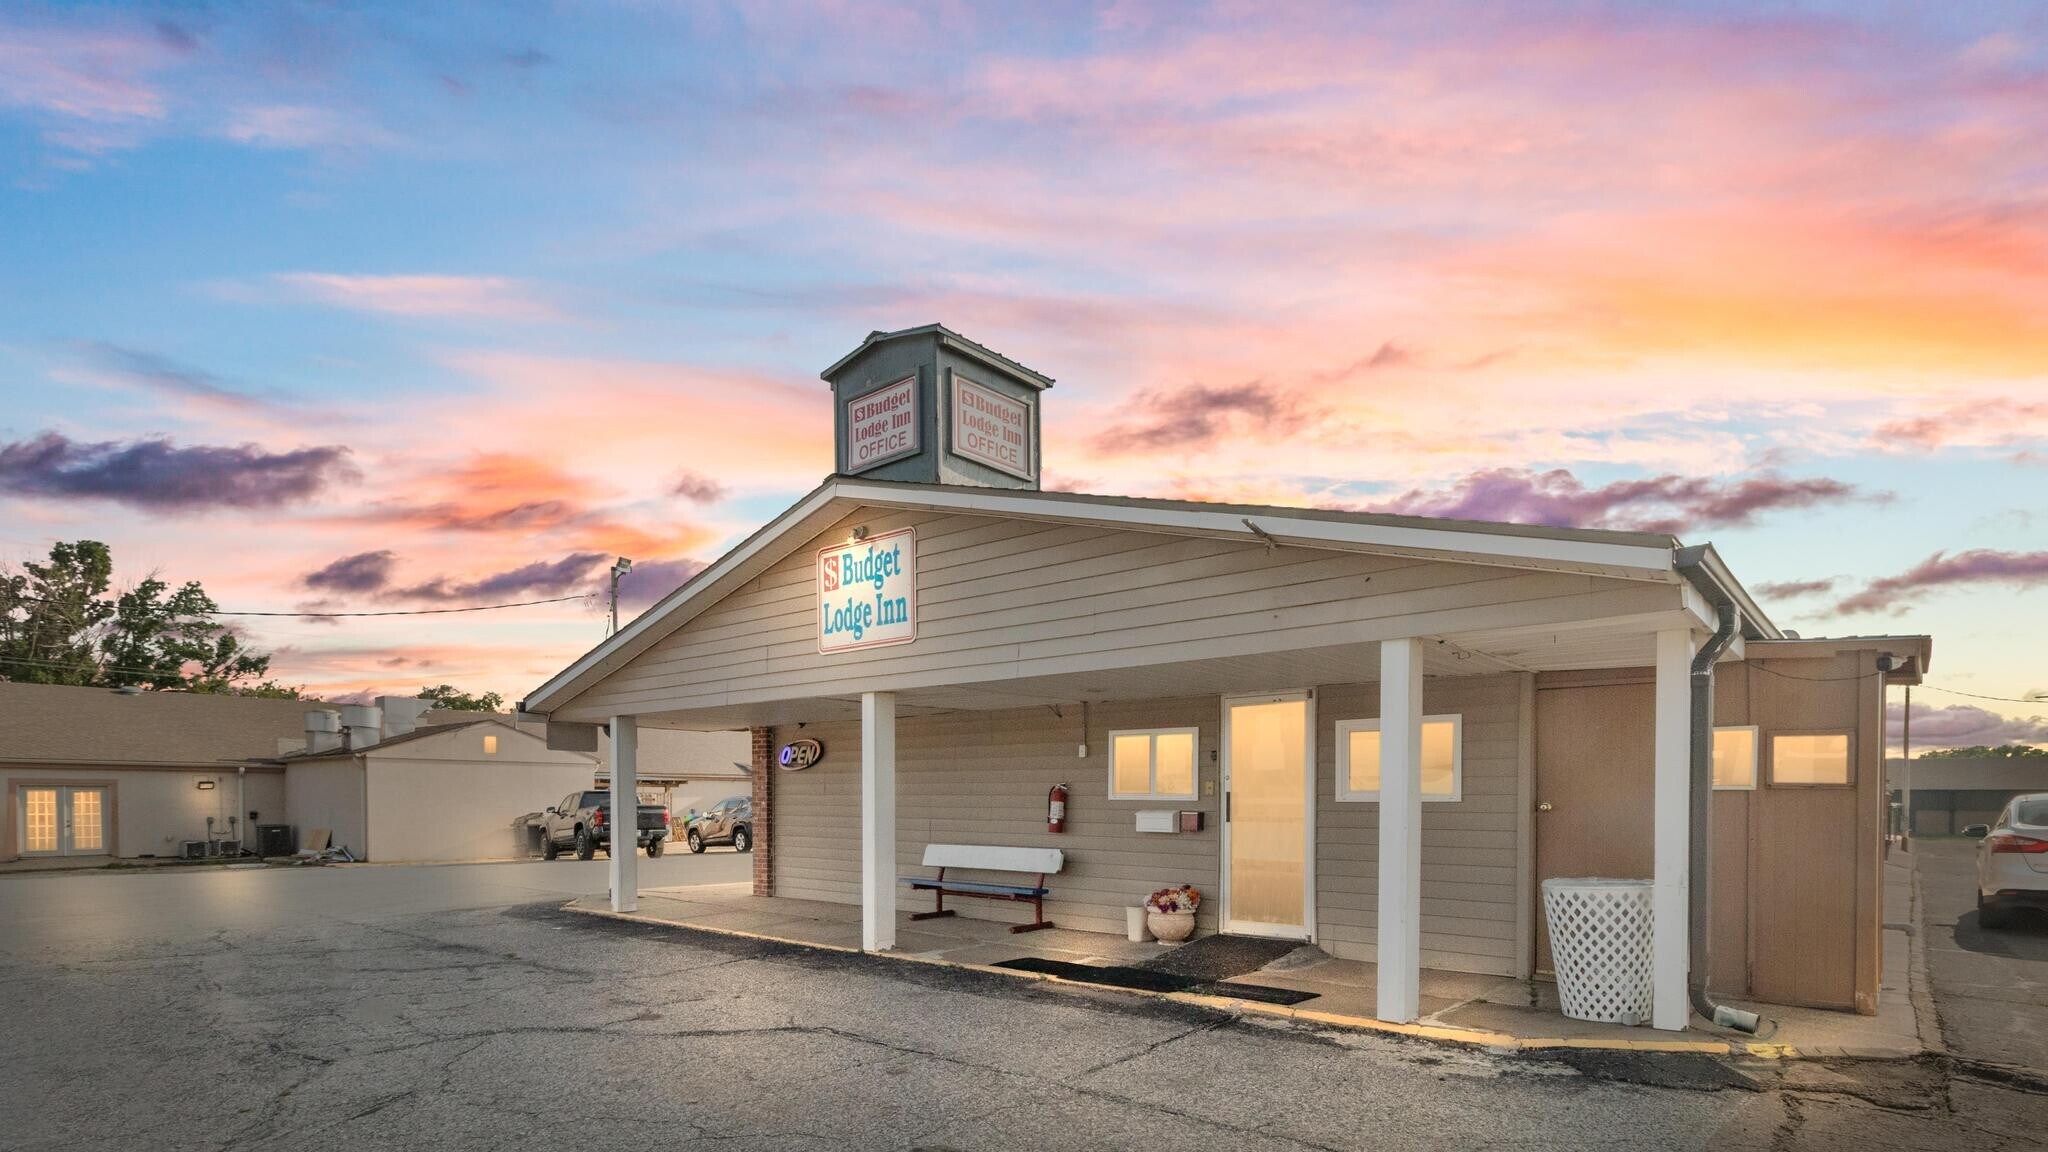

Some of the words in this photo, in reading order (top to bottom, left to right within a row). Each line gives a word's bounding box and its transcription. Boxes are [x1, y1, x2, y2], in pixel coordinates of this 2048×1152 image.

[866, 388, 910, 419] Budget
[975, 394, 1022, 427] Budget
[855, 420, 889, 443] Lodge
[892, 411, 911, 430] Inn
[963, 410, 999, 438] Lodge
[1002, 425, 1022, 446] Inn
[859, 430, 907, 460] OFFICE
[967, 432, 1017, 464] OFFICE
[842, 543, 901, 590] Budget
[823, 597, 872, 640] Lodge
[876, 593, 907, 626] Inn
[781, 745, 816, 765] OPEN
